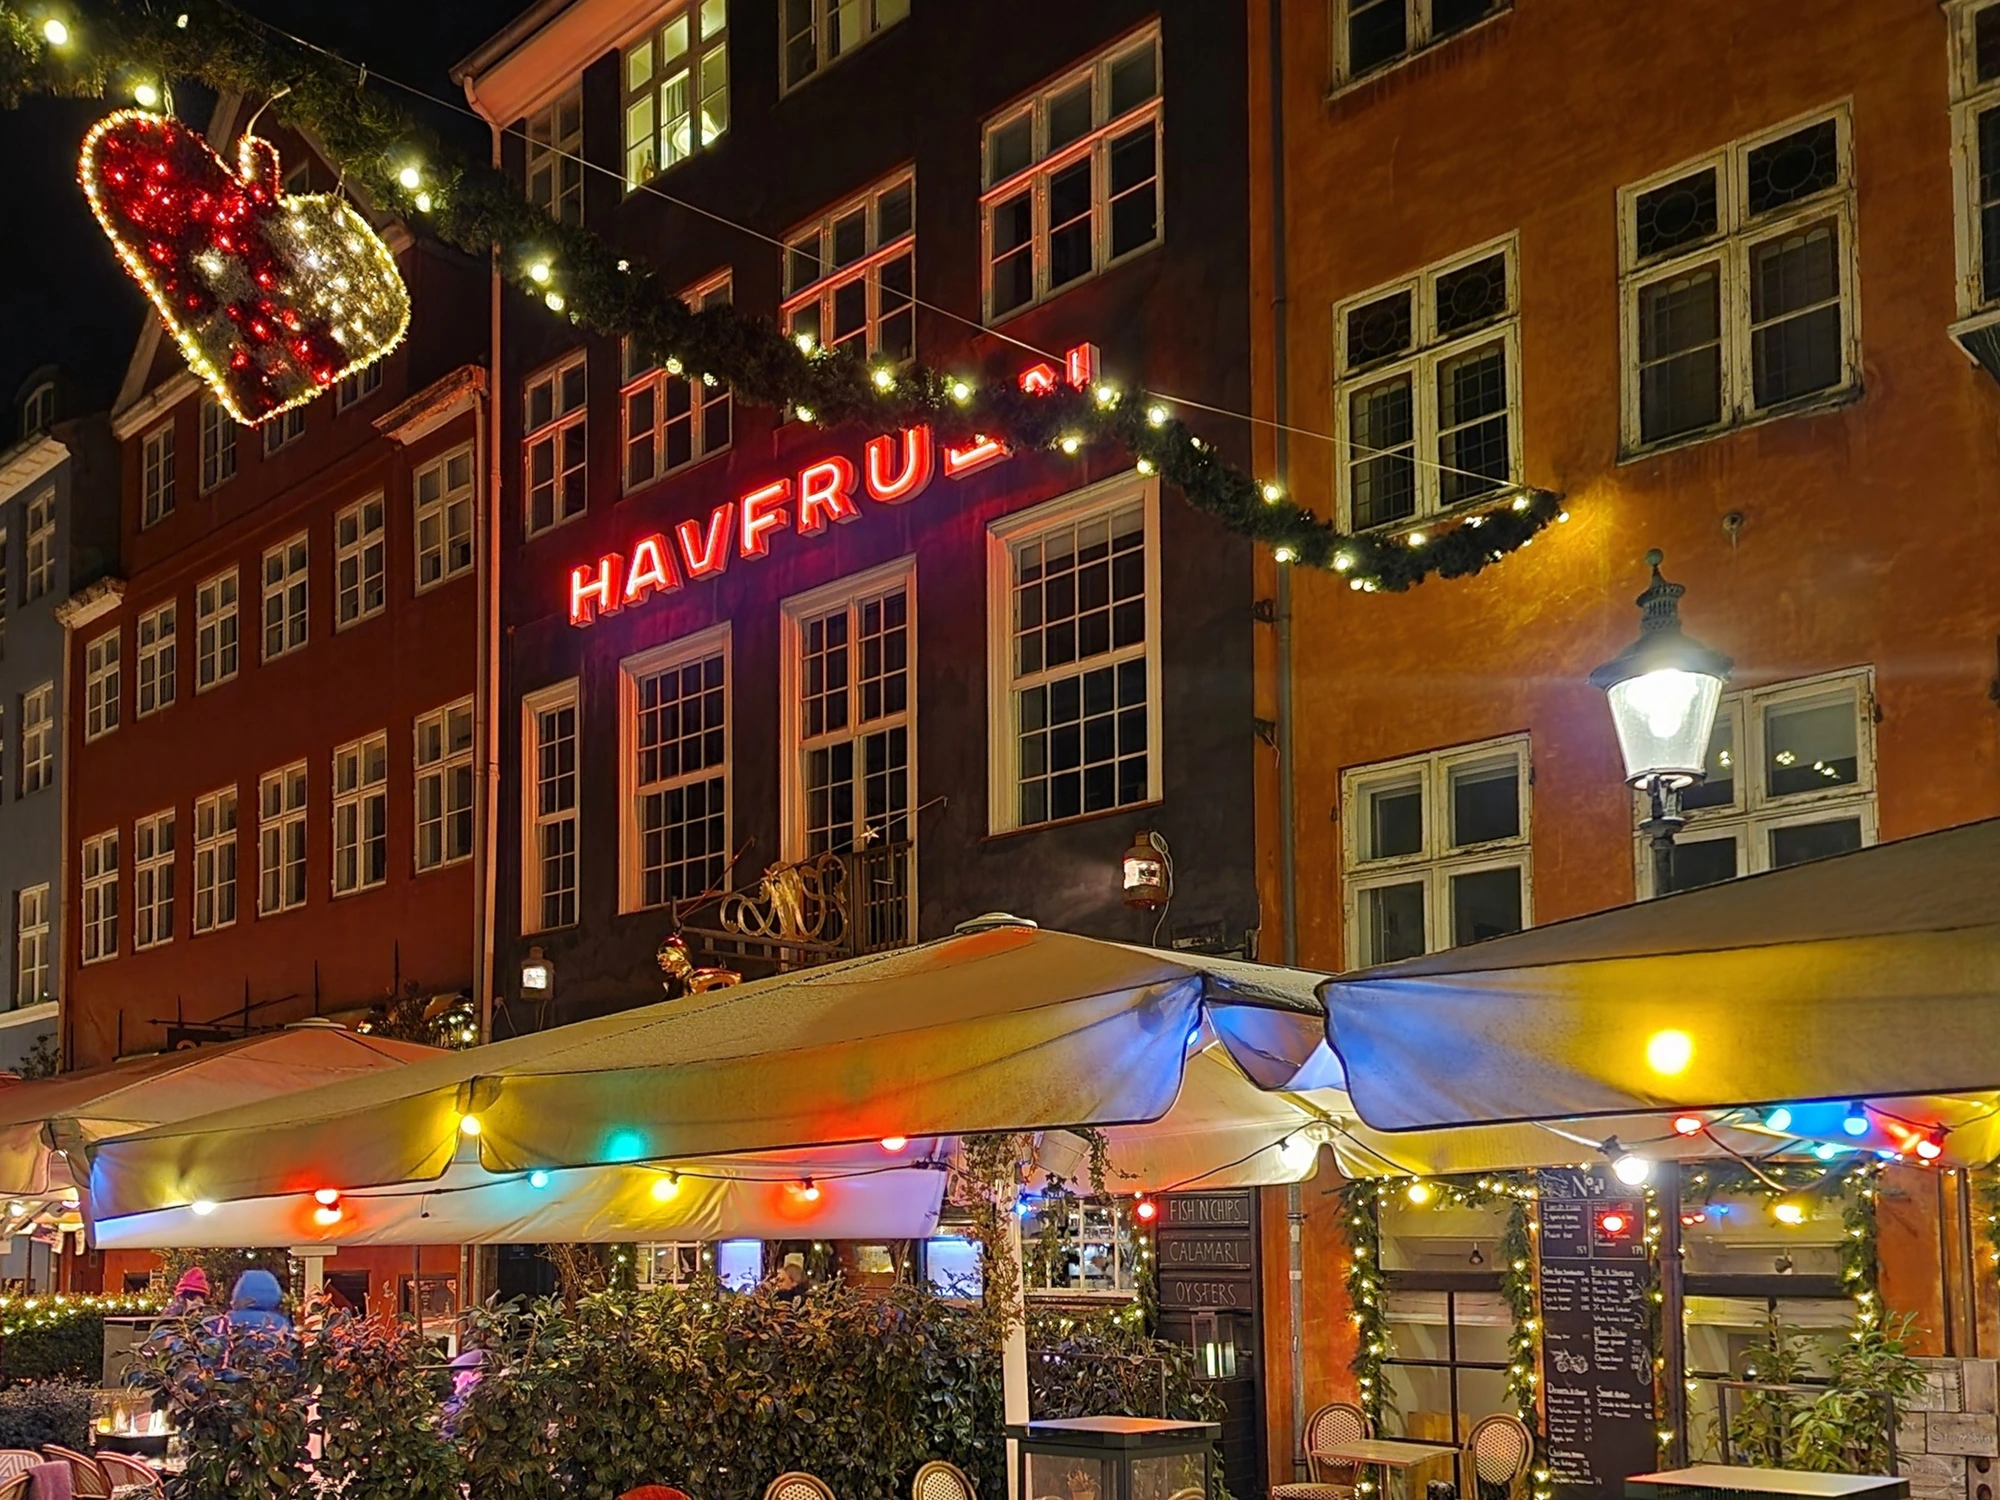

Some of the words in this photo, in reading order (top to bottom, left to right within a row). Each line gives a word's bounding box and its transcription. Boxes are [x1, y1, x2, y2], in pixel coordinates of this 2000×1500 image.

[569, 341, 1100, 629] HAVFRU
[1169, 1200, 1195, 1221] FISH
[1210, 1200, 1241, 1221] CHIPS
[1169, 1241, 1240, 1262] CALAMARI
[1175, 1281, 1237, 1305] OYSTERS
